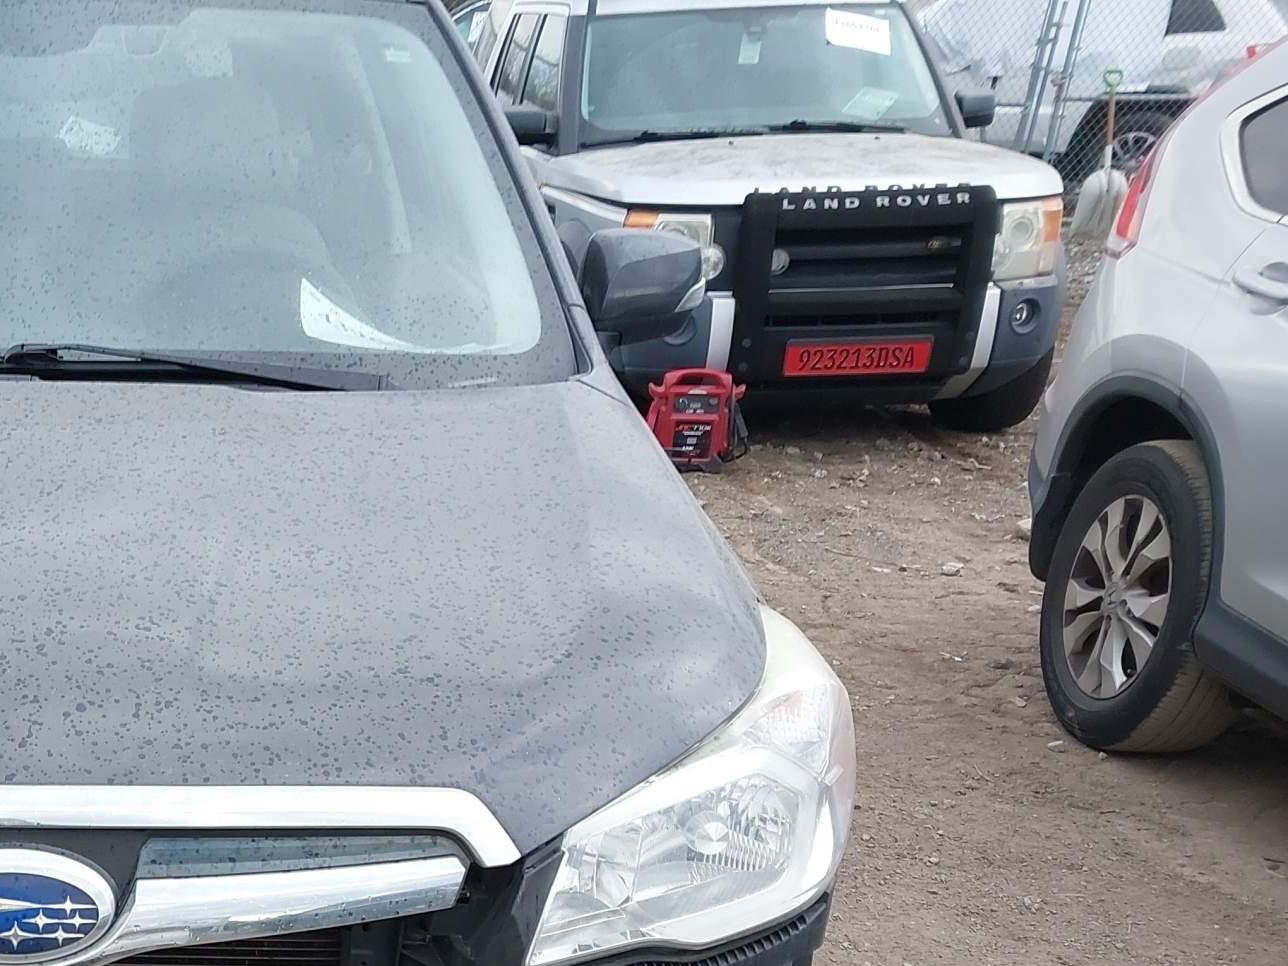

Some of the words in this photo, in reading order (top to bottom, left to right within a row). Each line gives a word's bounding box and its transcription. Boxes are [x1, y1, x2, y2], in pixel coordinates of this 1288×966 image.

[781, 197, 860, 210] LAND
[875, 192, 971, 208] ROVER
[798, 346, 915, 371] 923213DSA
